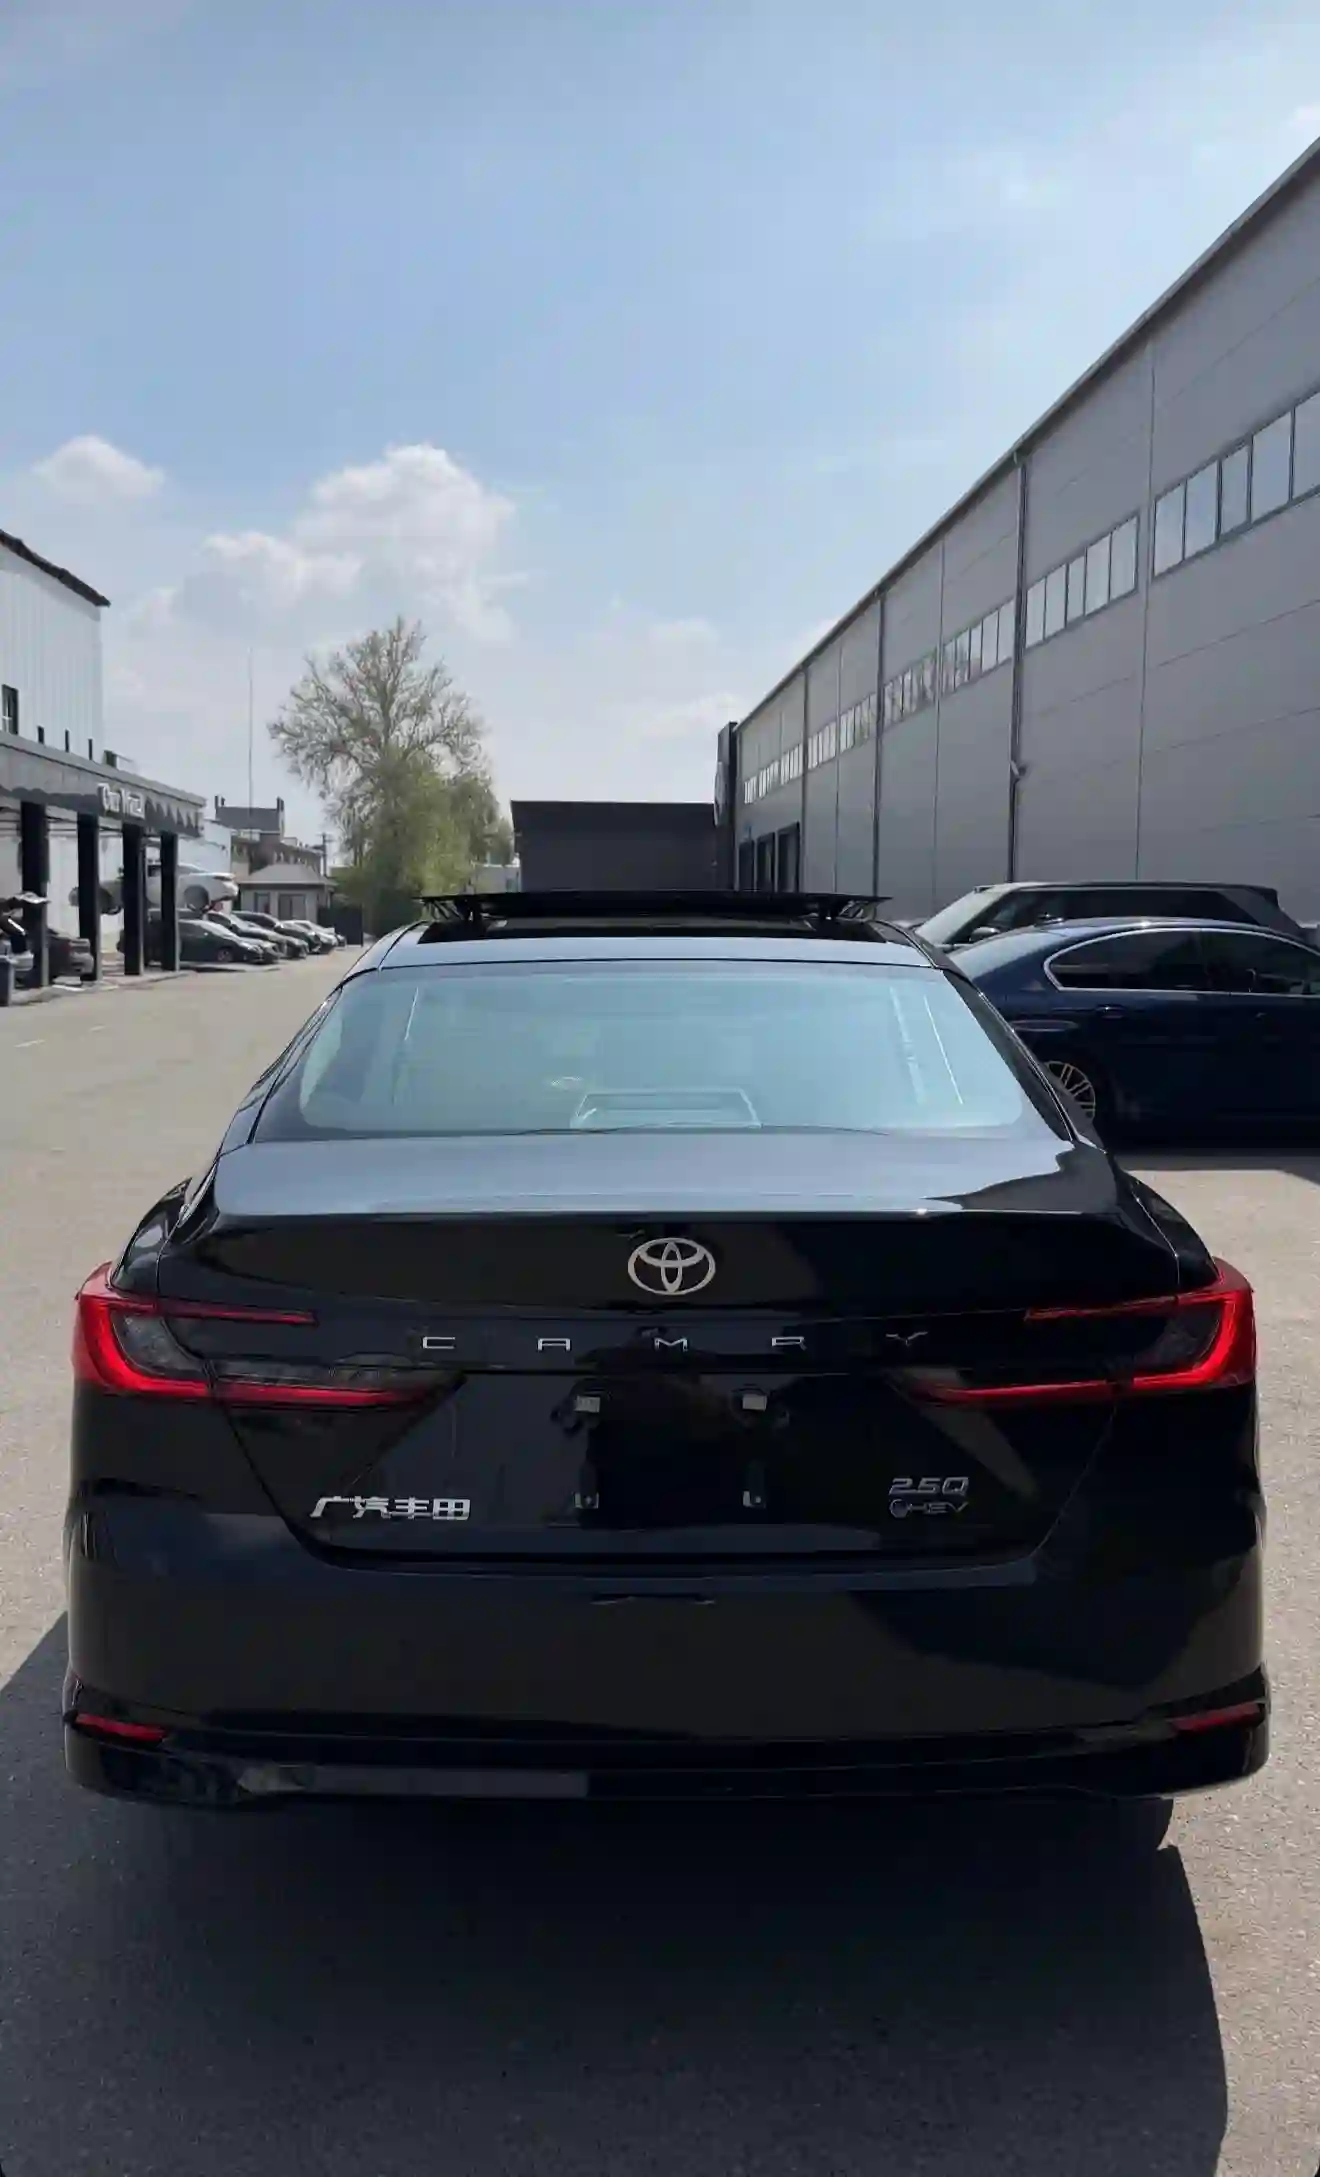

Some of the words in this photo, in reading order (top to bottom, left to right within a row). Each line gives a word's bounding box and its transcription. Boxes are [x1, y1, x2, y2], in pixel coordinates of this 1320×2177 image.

[421, 1331, 929, 1352] CAMRY
[309, 1495, 471, 1521] 广汽丰田
